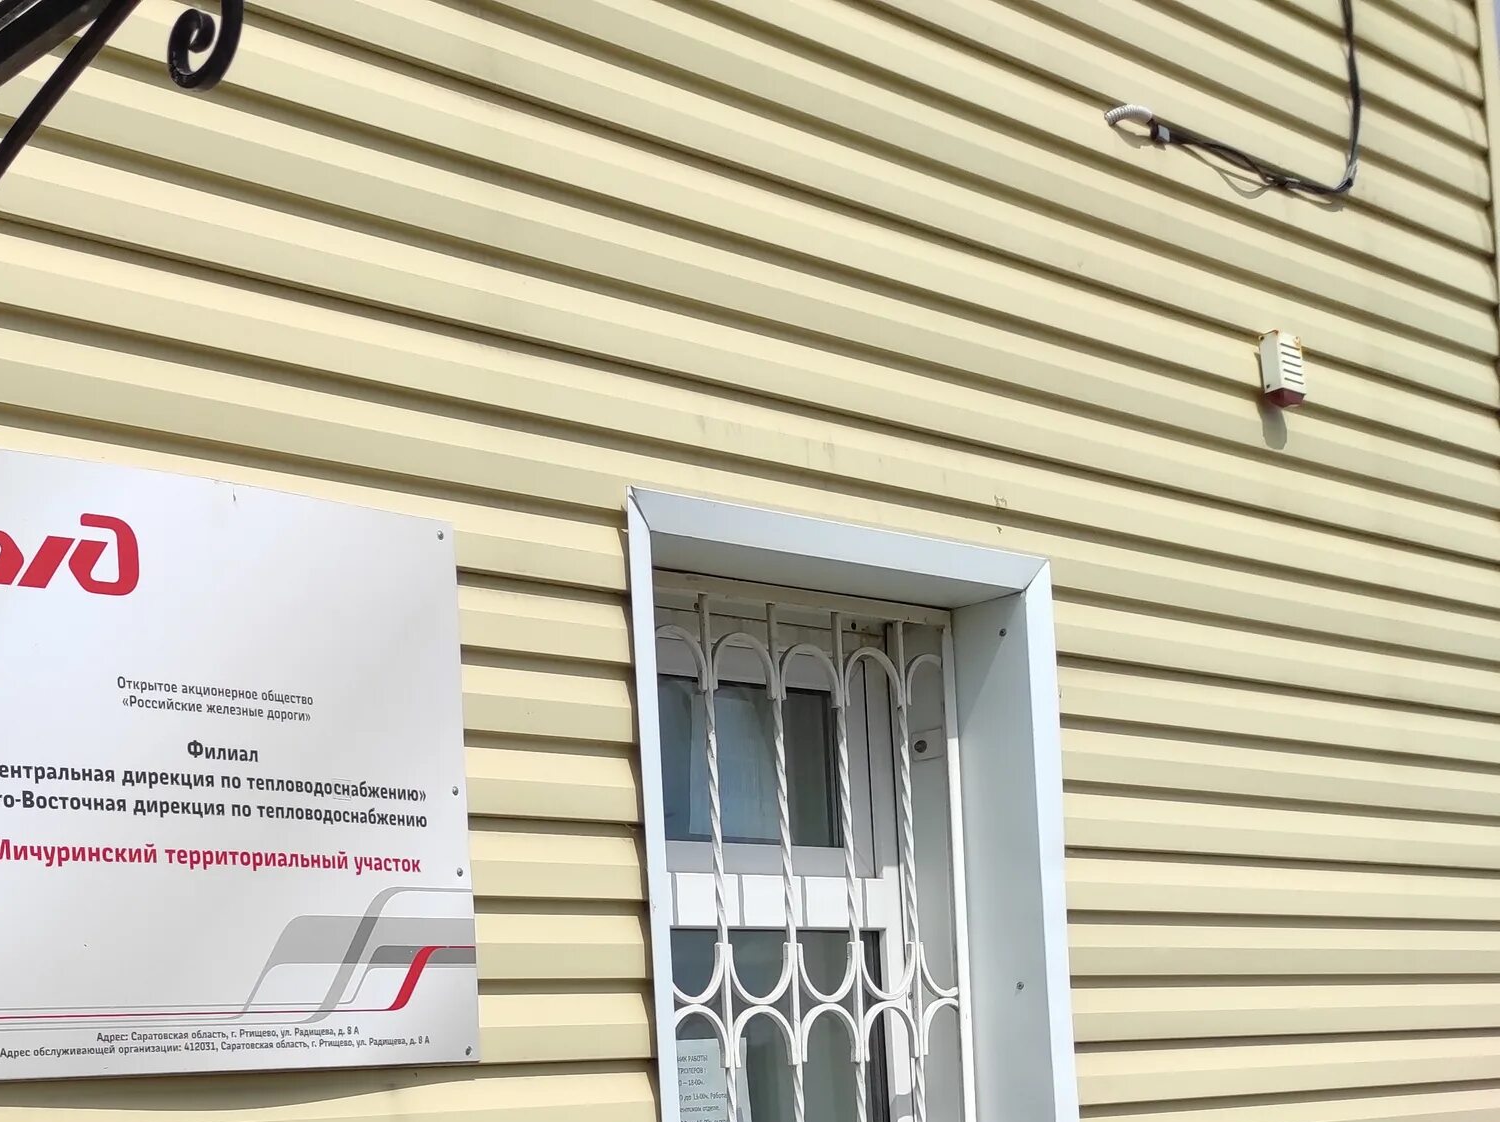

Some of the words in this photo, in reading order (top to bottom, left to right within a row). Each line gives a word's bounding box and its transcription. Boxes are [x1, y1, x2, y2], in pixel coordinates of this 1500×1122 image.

[117, 676, 177, 694] Открытое
[182, 685, 258, 700] акционерное
[262, 690, 313, 705] общество
[123, 696, 202, 712] «Российские
[206, 704, 263, 717] железные
[267, 710, 310, 722] дороги»
[187, 740, 258, 762] Филиал
[122, 771, 214, 789] дирекция
[221, 776, 241, 789] по
[247, 777, 426, 801] тепловодоснабжению»
[133, 800, 225, 818] дирекция
[232, 804, 251, 817] по
[257, 806, 427, 827] тепловодоснабжению
[165, 849, 348, 871] территориальный
[354, 857, 421, 875] участок
[0, 1048, 30, 1060] Адрес
[33, 1045, 115, 1058] обслуживающей
[118, 1043, 181, 1056] организации:
[184, 1042, 218, 1052] 412031,
[221, 1041, 273, 1052] Саратовская
[276, 1037, 309, 1049] область,
[319, 1036, 354, 1048] Ртищево,
[356, 1040, 367, 1048] ул.
[369, 1038, 408, 1047] Радищева,
[97, 1033, 128, 1044] Адрес:
[131, 1032, 188, 1043] Саратовская
[191, 1030, 229, 1041] область,
[239, 1029, 278, 1038] Ртищево,
[280, 1029, 292, 1038] ул.
[295, 1028, 336, 1038] Радищева,
